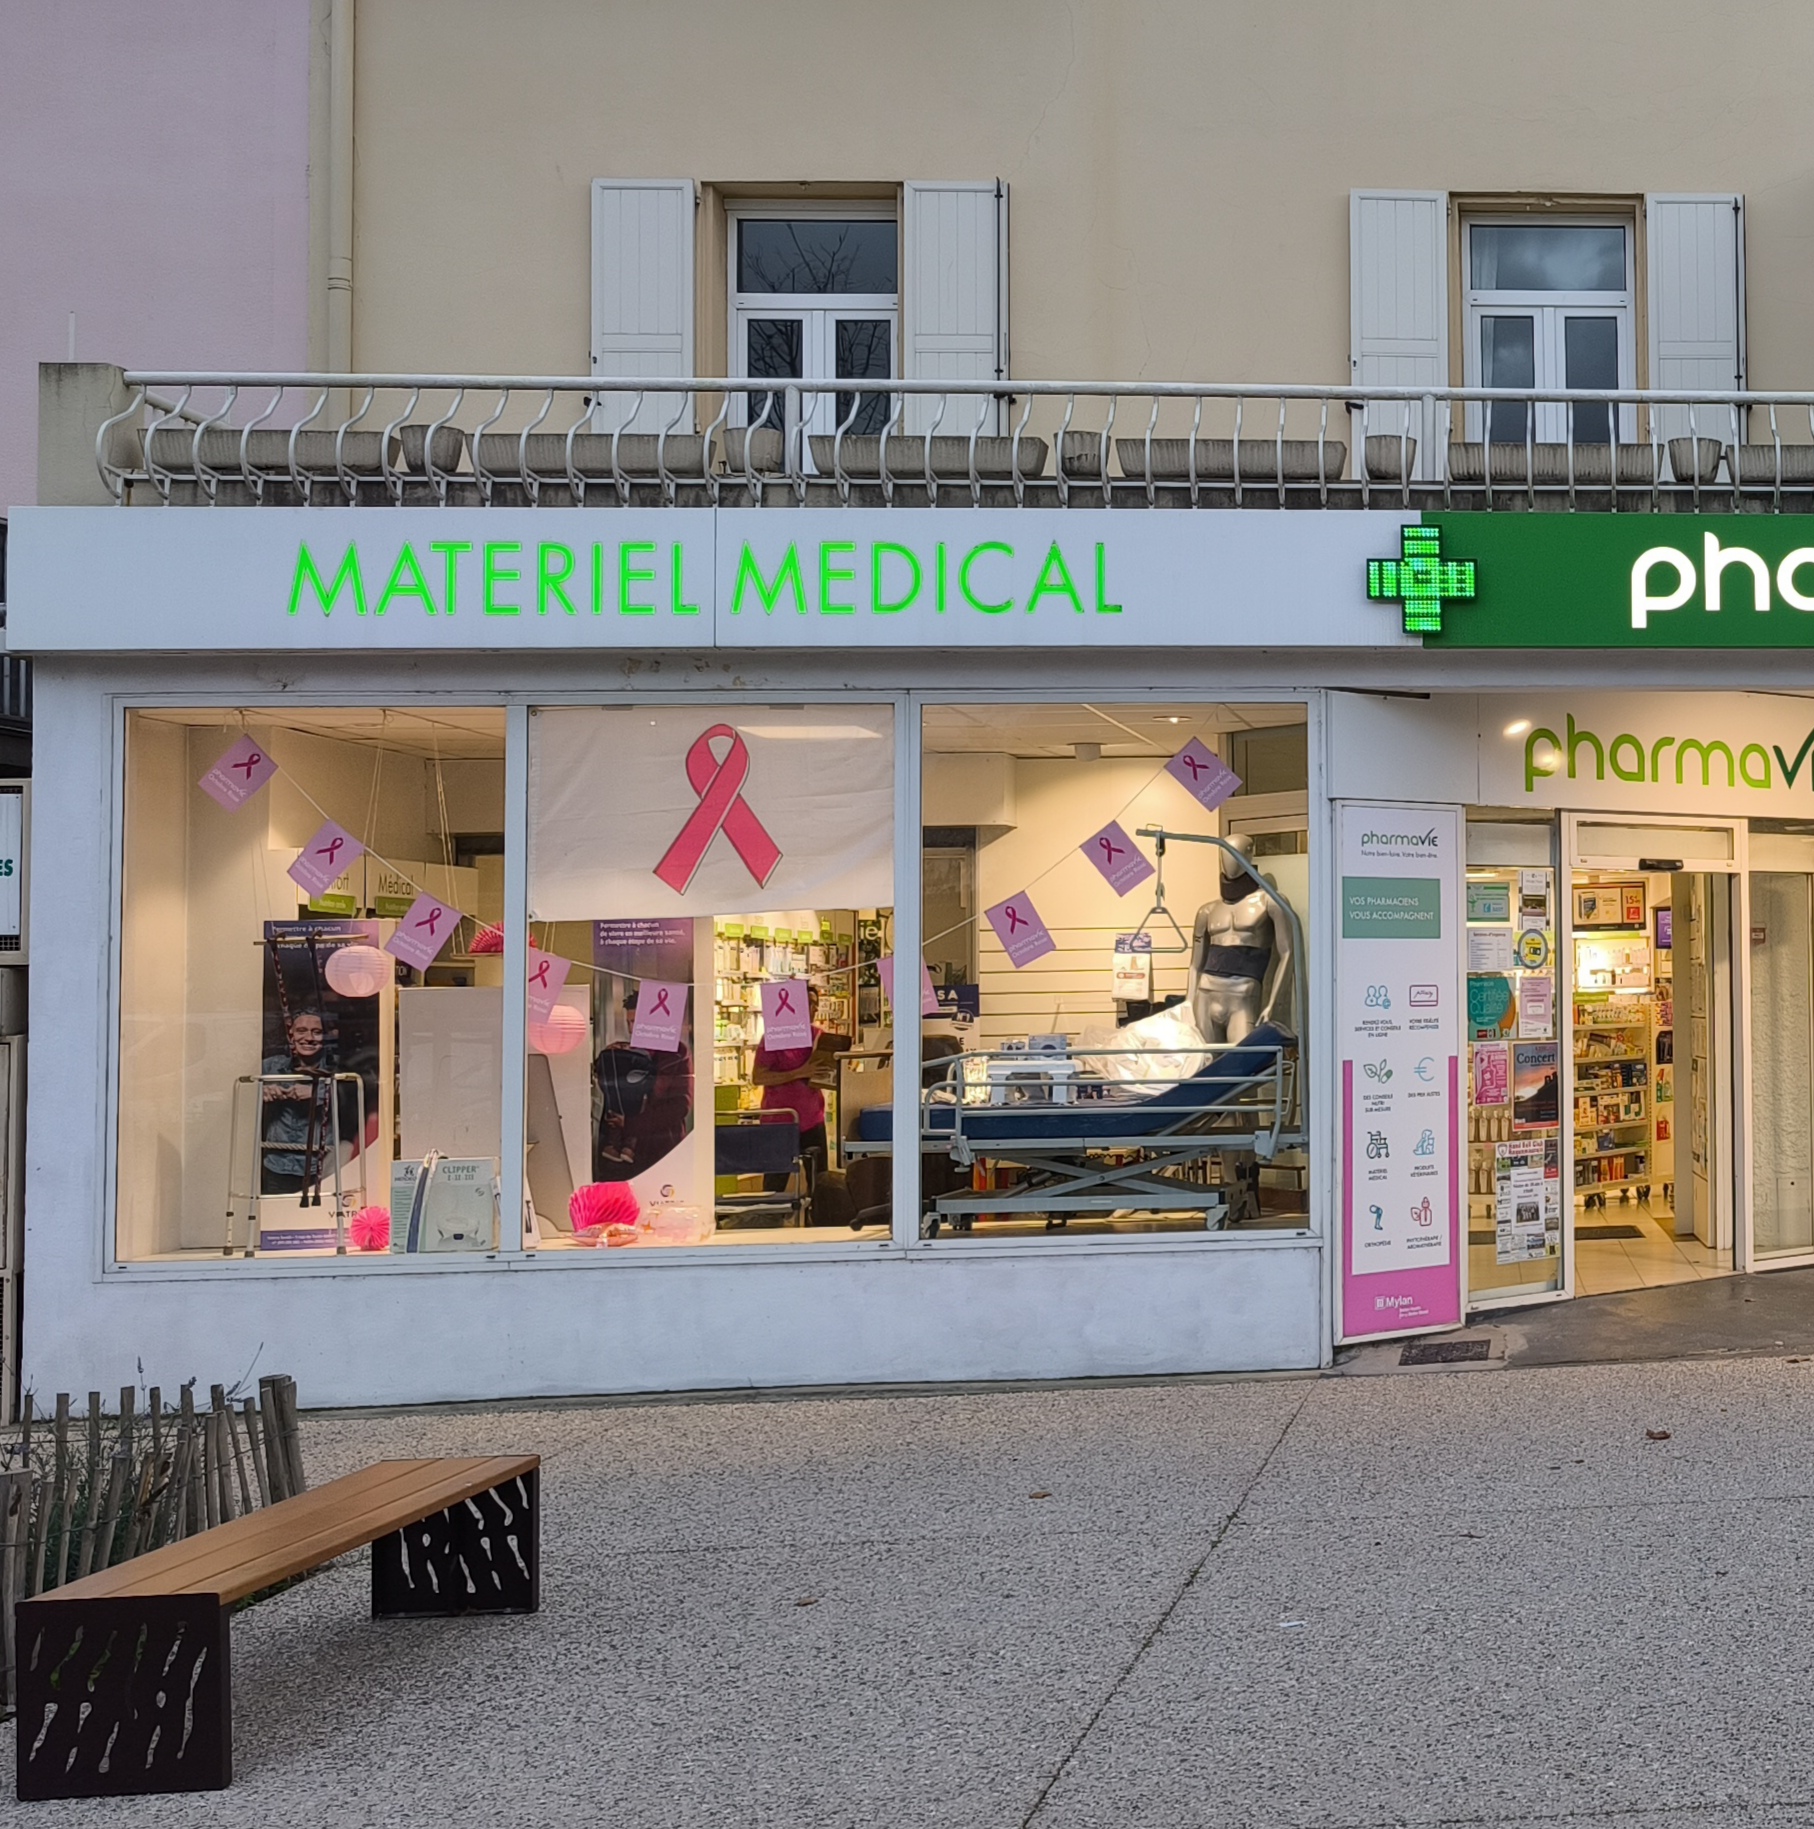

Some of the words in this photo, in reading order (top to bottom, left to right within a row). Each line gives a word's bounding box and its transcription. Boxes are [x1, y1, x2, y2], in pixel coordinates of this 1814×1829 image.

[287, 540, 700, 617] MATERIEL
[729, 540, 1123, 616] MEDICAL
[378, 873, 414, 895] Médical
[1349, 897, 1365, 905] VOS
[1367, 897, 1418, 906] PHARMACIENS
[1349, 911, 1370, 920] VOUS
[1372, 911, 1434, 920] ACCOMPAGNENT
[1517, 1053, 1555, 1064] Concert
[442, 1166, 477, 1174] CLIPPER
[1386, 1295, 1413, 1308] Mylan
